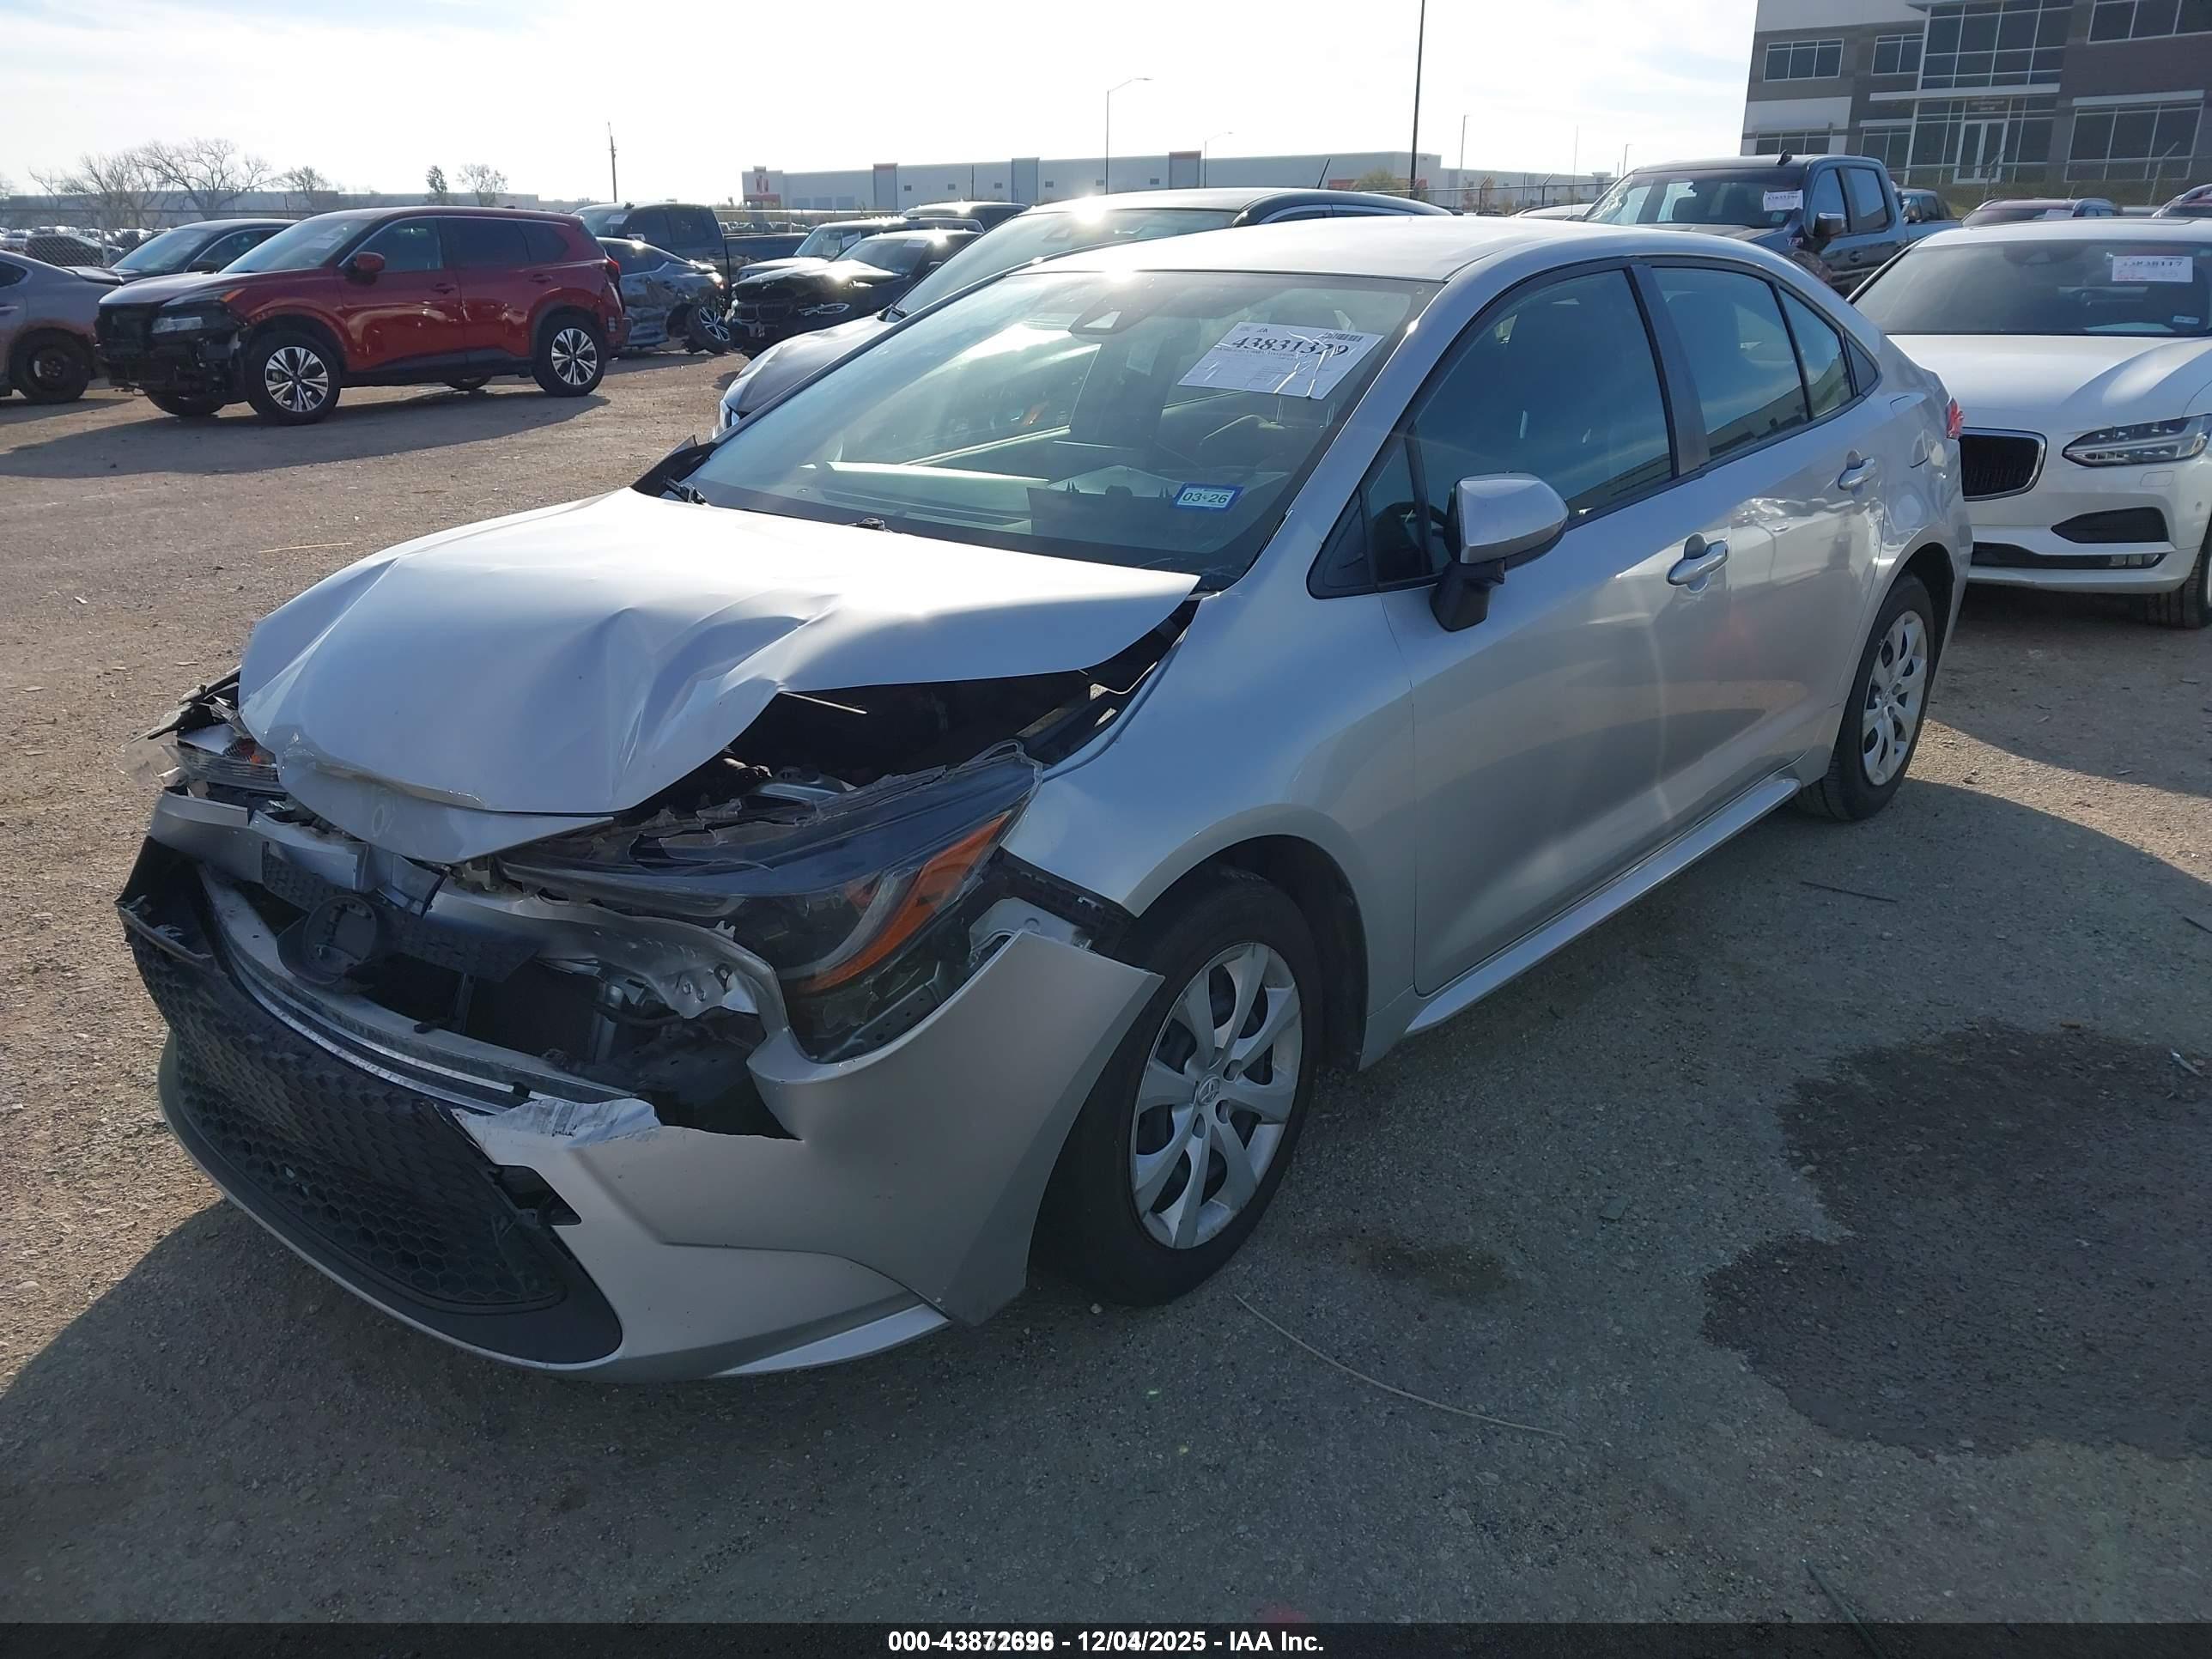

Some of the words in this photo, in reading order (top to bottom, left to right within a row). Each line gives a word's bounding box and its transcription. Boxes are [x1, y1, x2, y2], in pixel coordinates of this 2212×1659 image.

[1232, 336, 1349, 356] 43831329
[1182, 492, 1202, 502] 03
[1208, 494, 1229, 504] 26
